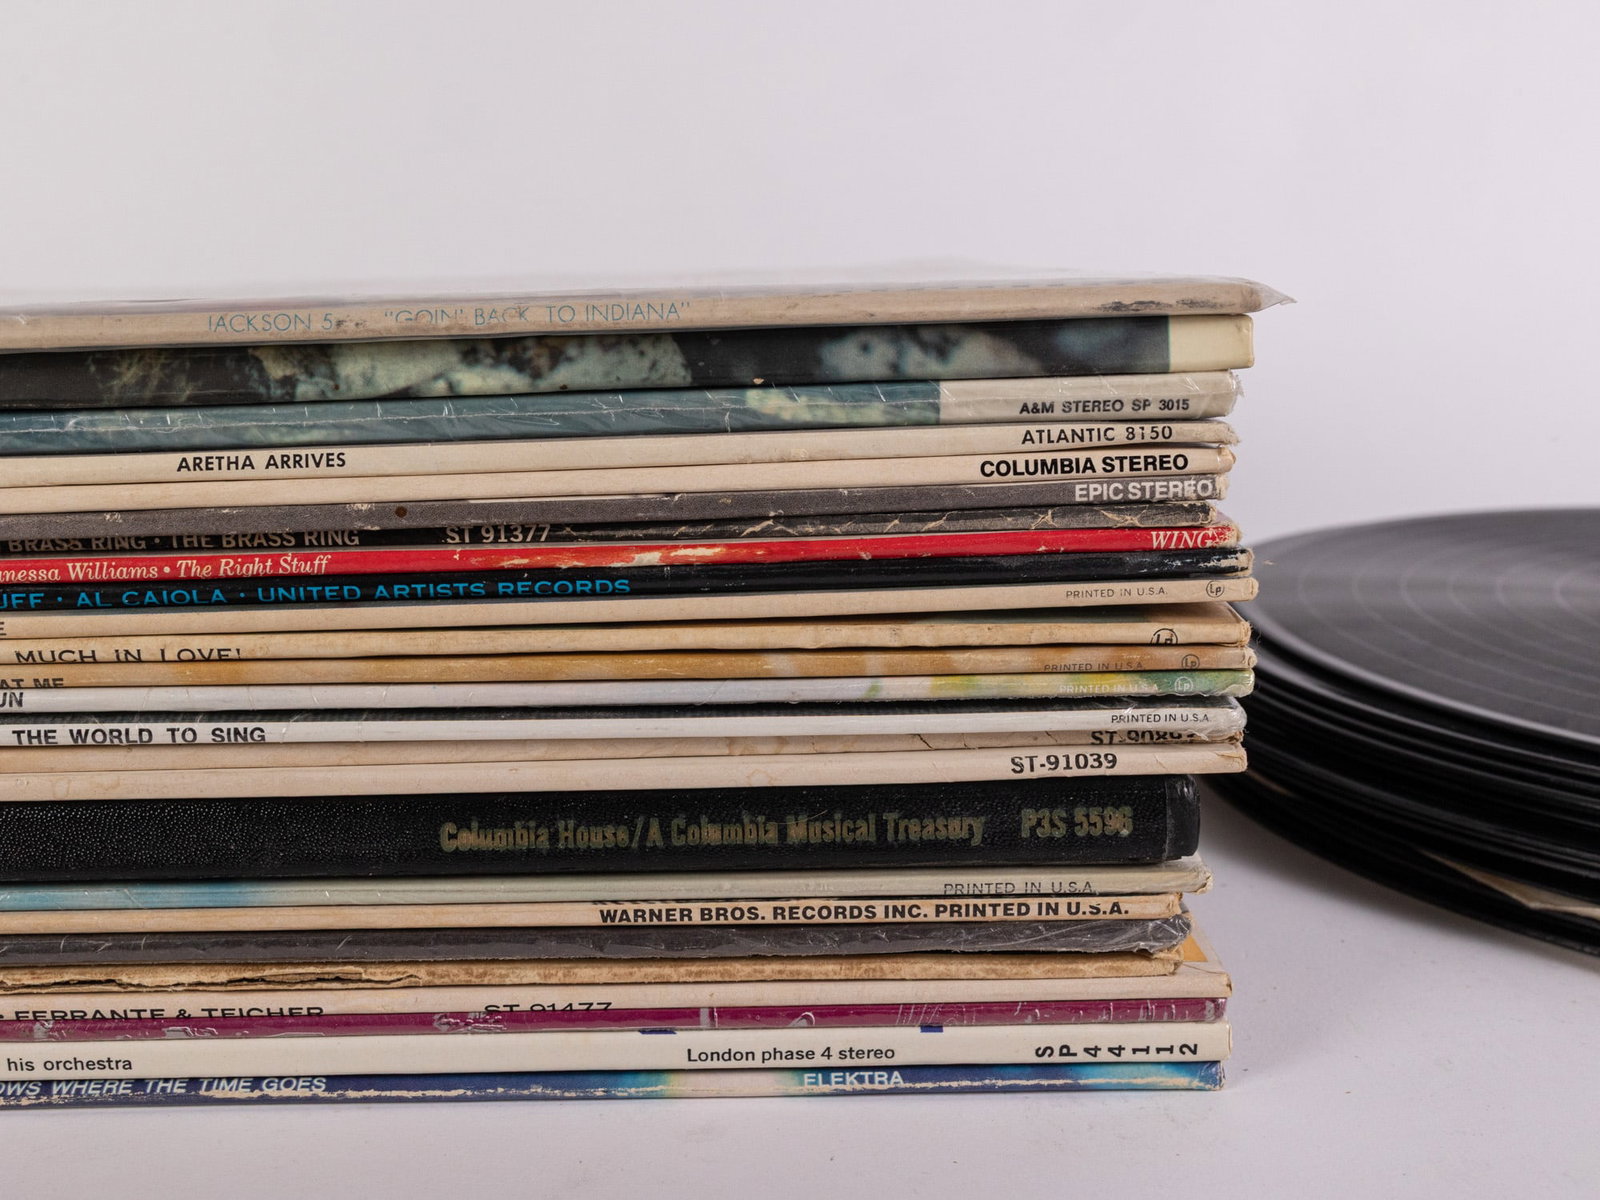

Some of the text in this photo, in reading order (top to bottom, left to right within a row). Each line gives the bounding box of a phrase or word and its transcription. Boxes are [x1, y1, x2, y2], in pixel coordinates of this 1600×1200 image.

[320, 312, 334, 332] 5
[474, 306, 529, 326] BACK
[546, 304, 576, 323] TO
[585, 302, 690, 322] INDIANA"
[1019, 398, 1190, 415] A&M STEREO SP 3015
[1021, 425, 1173, 445] ATLANTIC 8150
[176, 452, 347, 473] ARETHA ARRIVES
[980, 453, 1189, 478] COLUMBIA STEREO
[1074, 479, 1214, 502] EPIC STEREO
[8, 530, 361, 553] BRASS RING THE BRASS RING
[445, 524, 551, 544] ST 91377
[67, 560, 159, 582] Williams
[176, 558, 213, 579] The
[218, 556, 274, 579] Right
[278, 553, 332, 576] Stuff
[76, 591, 113, 607] AL
[121, 588, 228, 607] CAIOLA
[257, 585, 362, 603] UNITED
[374, 581, 487, 600] ARTISTS
[497, 579, 632, 597] RECORDS
[1065, 587, 1169, 599] PRINTED IN U.S.A.
[14, 647, 242, 664] MUCH IN LOVE!
[1043, 661, 1093, 672] PRINTED
[1097, 662, 1110, 672] IN
[1059, 683, 1115, 694] PRINTED
[1115, 684, 1126, 693] IN
[1111, 712, 1212, 724] PRINTED IN U.S.A.
[12, 726, 267, 746] THE WORLD TO SING
[1010, 752, 1118, 774] ST-91039
[439, 817, 550, 852] Columbia
[670, 814, 778, 847] Columbia
[786, 812, 876, 845] Musical
[882, 811, 985, 847] Treasury
[1020, 807, 1068, 839] P3S
[943, 882, 1016, 895] PRINTED
[1024, 881, 1042, 894] IN
[599, 901, 1130, 924] WARNER BROS. RECORDS INC. PRINTED IN U.S.A.
[6, 1056, 133, 1072] his orchestra
[686, 1046, 896, 1064] London phase 4 stereo
[51, 1079, 135, 1095] WHERE
[144, 1078, 190, 1094] THE
[199, 1077, 253, 1094] TIME
[260, 1076, 328, 1093] GOES
[803, 1070, 906, 1087] ELEKTRA
